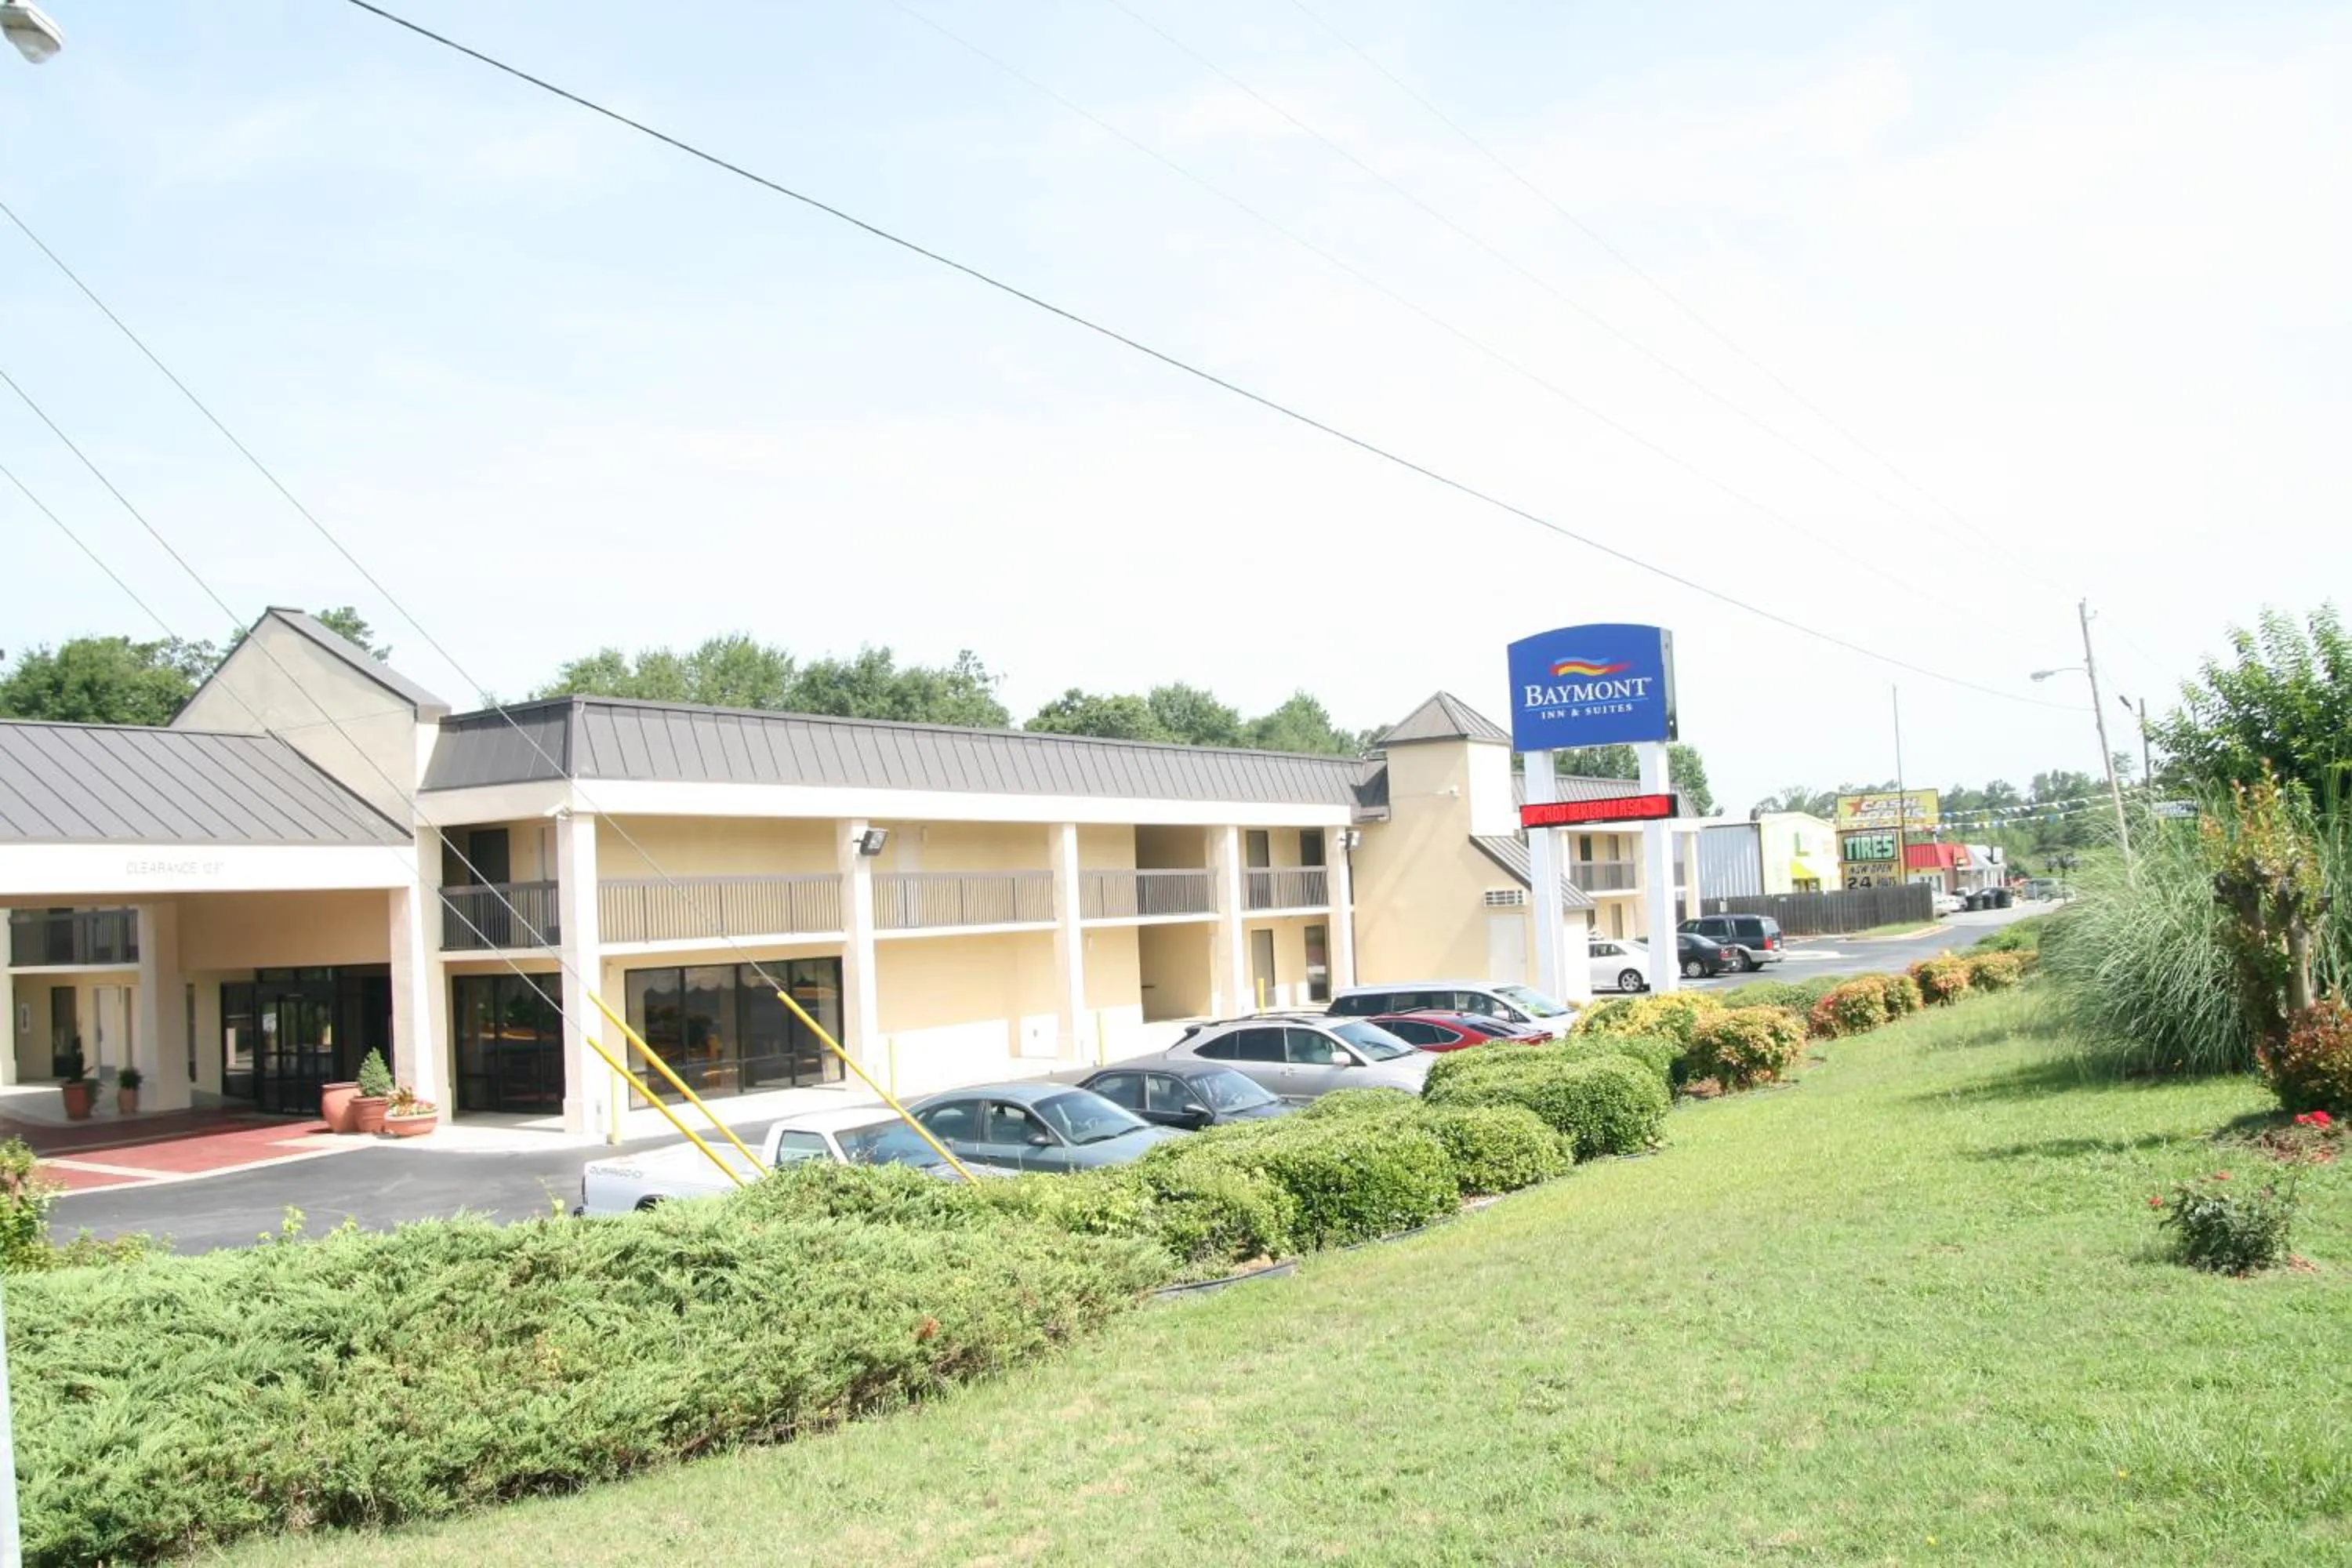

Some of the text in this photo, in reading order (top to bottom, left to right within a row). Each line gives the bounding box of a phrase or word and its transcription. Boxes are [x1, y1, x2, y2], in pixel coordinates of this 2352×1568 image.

[1524, 677, 1648, 708] BAYMONT
[1541, 710, 1565, 720] INN
[1585, 702, 1633, 716] SUITES
[1844, 835, 1894, 860] TIRES
[126, 861, 198, 875] CLEARANCE
[1848, 876, 1871, 890] 24
